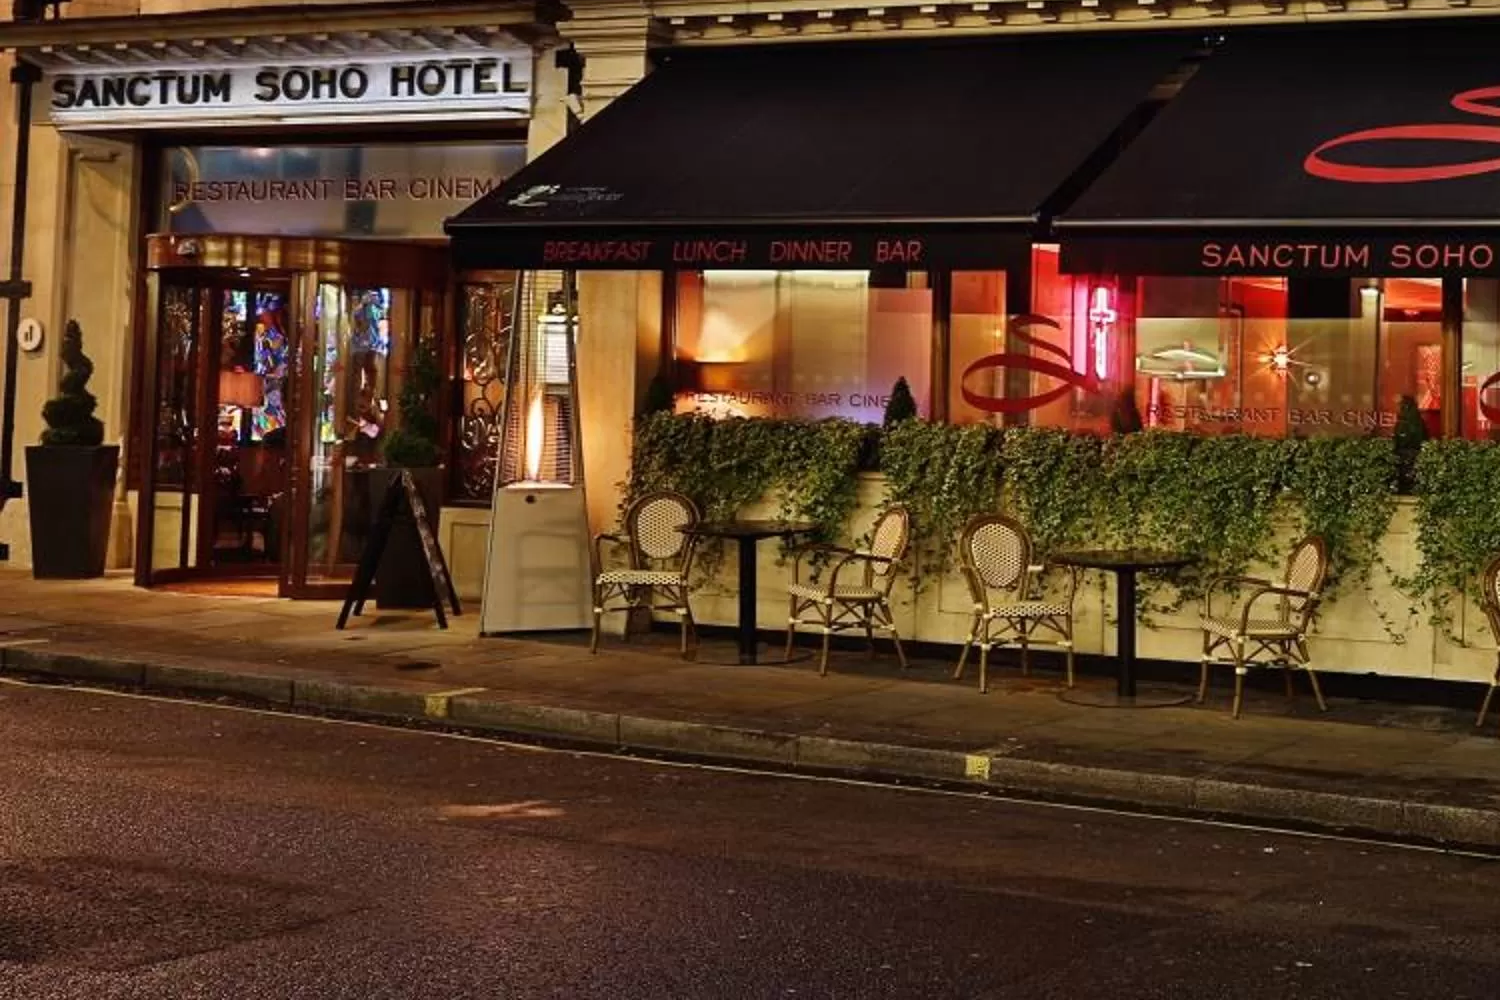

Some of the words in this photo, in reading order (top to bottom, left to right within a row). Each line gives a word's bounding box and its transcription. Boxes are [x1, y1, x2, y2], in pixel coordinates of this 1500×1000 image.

[53, 72, 231, 109] SANCTUM
[255, 64, 369, 102] SOHO
[390, 57, 528, 97] HOTEL
[173, 178, 335, 202] RESTAURANT
[345, 178, 397, 200] BAR
[407, 176, 504, 200] CINEM
[543, 241, 653, 262] BREAKFAST
[673, 241, 747, 262] LUNCH
[770, 241, 851, 262] DINNER
[876, 241, 922, 262] BAR
[1202, 244, 1370, 269] SANCTUM
[1391, 244, 1493, 269] SOHO
[849, 393, 890, 408] CINE
[1288, 409, 1331, 426] BAR
[1342, 410, 1398, 428] CINE
